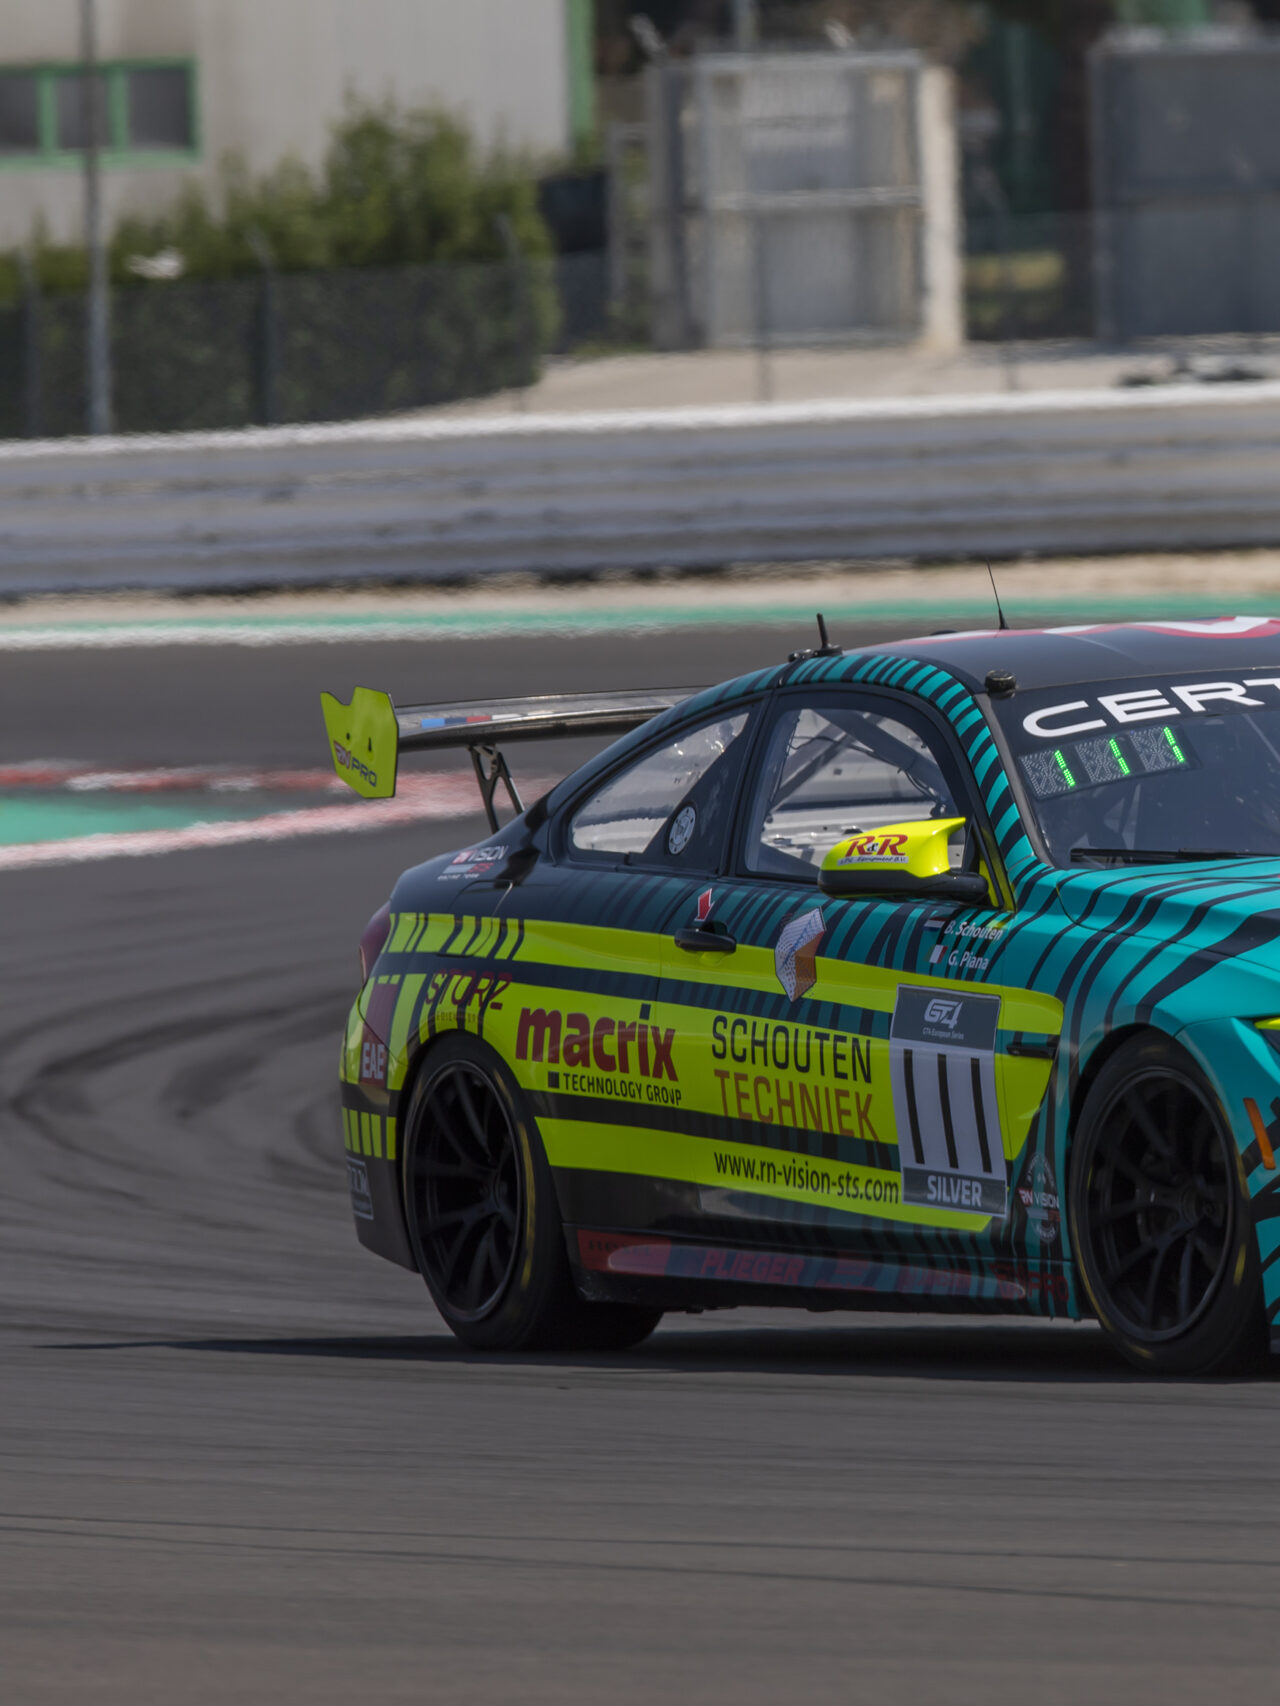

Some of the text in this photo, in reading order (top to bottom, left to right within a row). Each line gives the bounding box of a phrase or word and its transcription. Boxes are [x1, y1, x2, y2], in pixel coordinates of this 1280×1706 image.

[351, 757, 378, 788] PRO
[1054, 726, 1185, 788] 111
[845, 834, 908, 857] R&R
[944, 920, 1004, 940] B. Schouten
[948, 950, 990, 970] G. Piana
[425, 968, 513, 1011] STORZ
[924, 998, 963, 1029] GT4
[362, 1042, 386, 1080] EAE
[516, 1003, 679, 1082] macrix
[711, 1015, 872, 1084] SCHOUTEN
[563, 1072, 682, 1106] TECHNOLOGY GROUP
[714, 1068, 880, 1142] TECHNIEK
[903, 1048, 993, 1174] 111
[714, 1152, 899, 1205] www.rn-vision-sts.com
[927, 1175, 982, 1208] SILVER
[700, 1249, 805, 1286] PLIEGER
[1027, 1271, 1070, 1303] PRO
